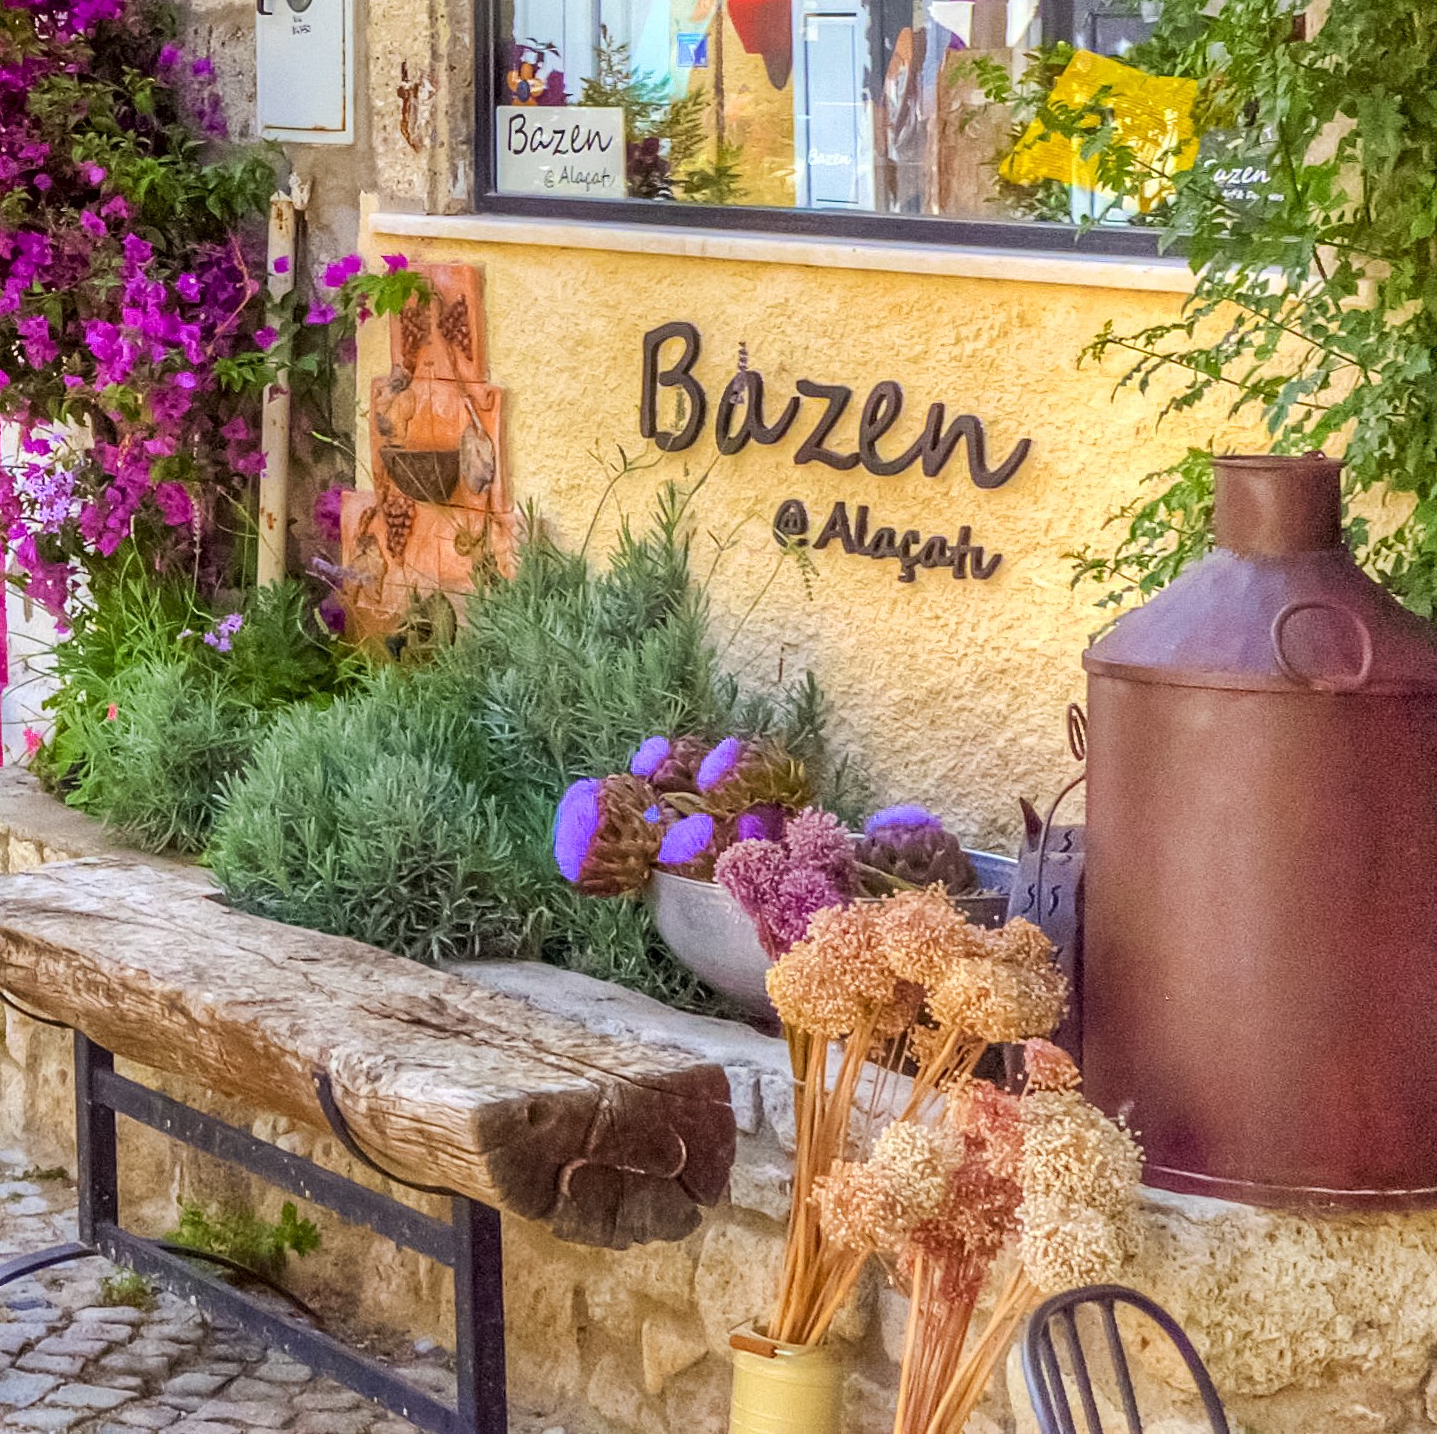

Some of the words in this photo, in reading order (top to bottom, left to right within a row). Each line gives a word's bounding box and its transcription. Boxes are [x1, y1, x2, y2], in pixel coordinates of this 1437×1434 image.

[508, 113, 613, 156] Bazen
[1204, 159, 1271, 184] azen
[639, 320, 1032, 490] Bazen
